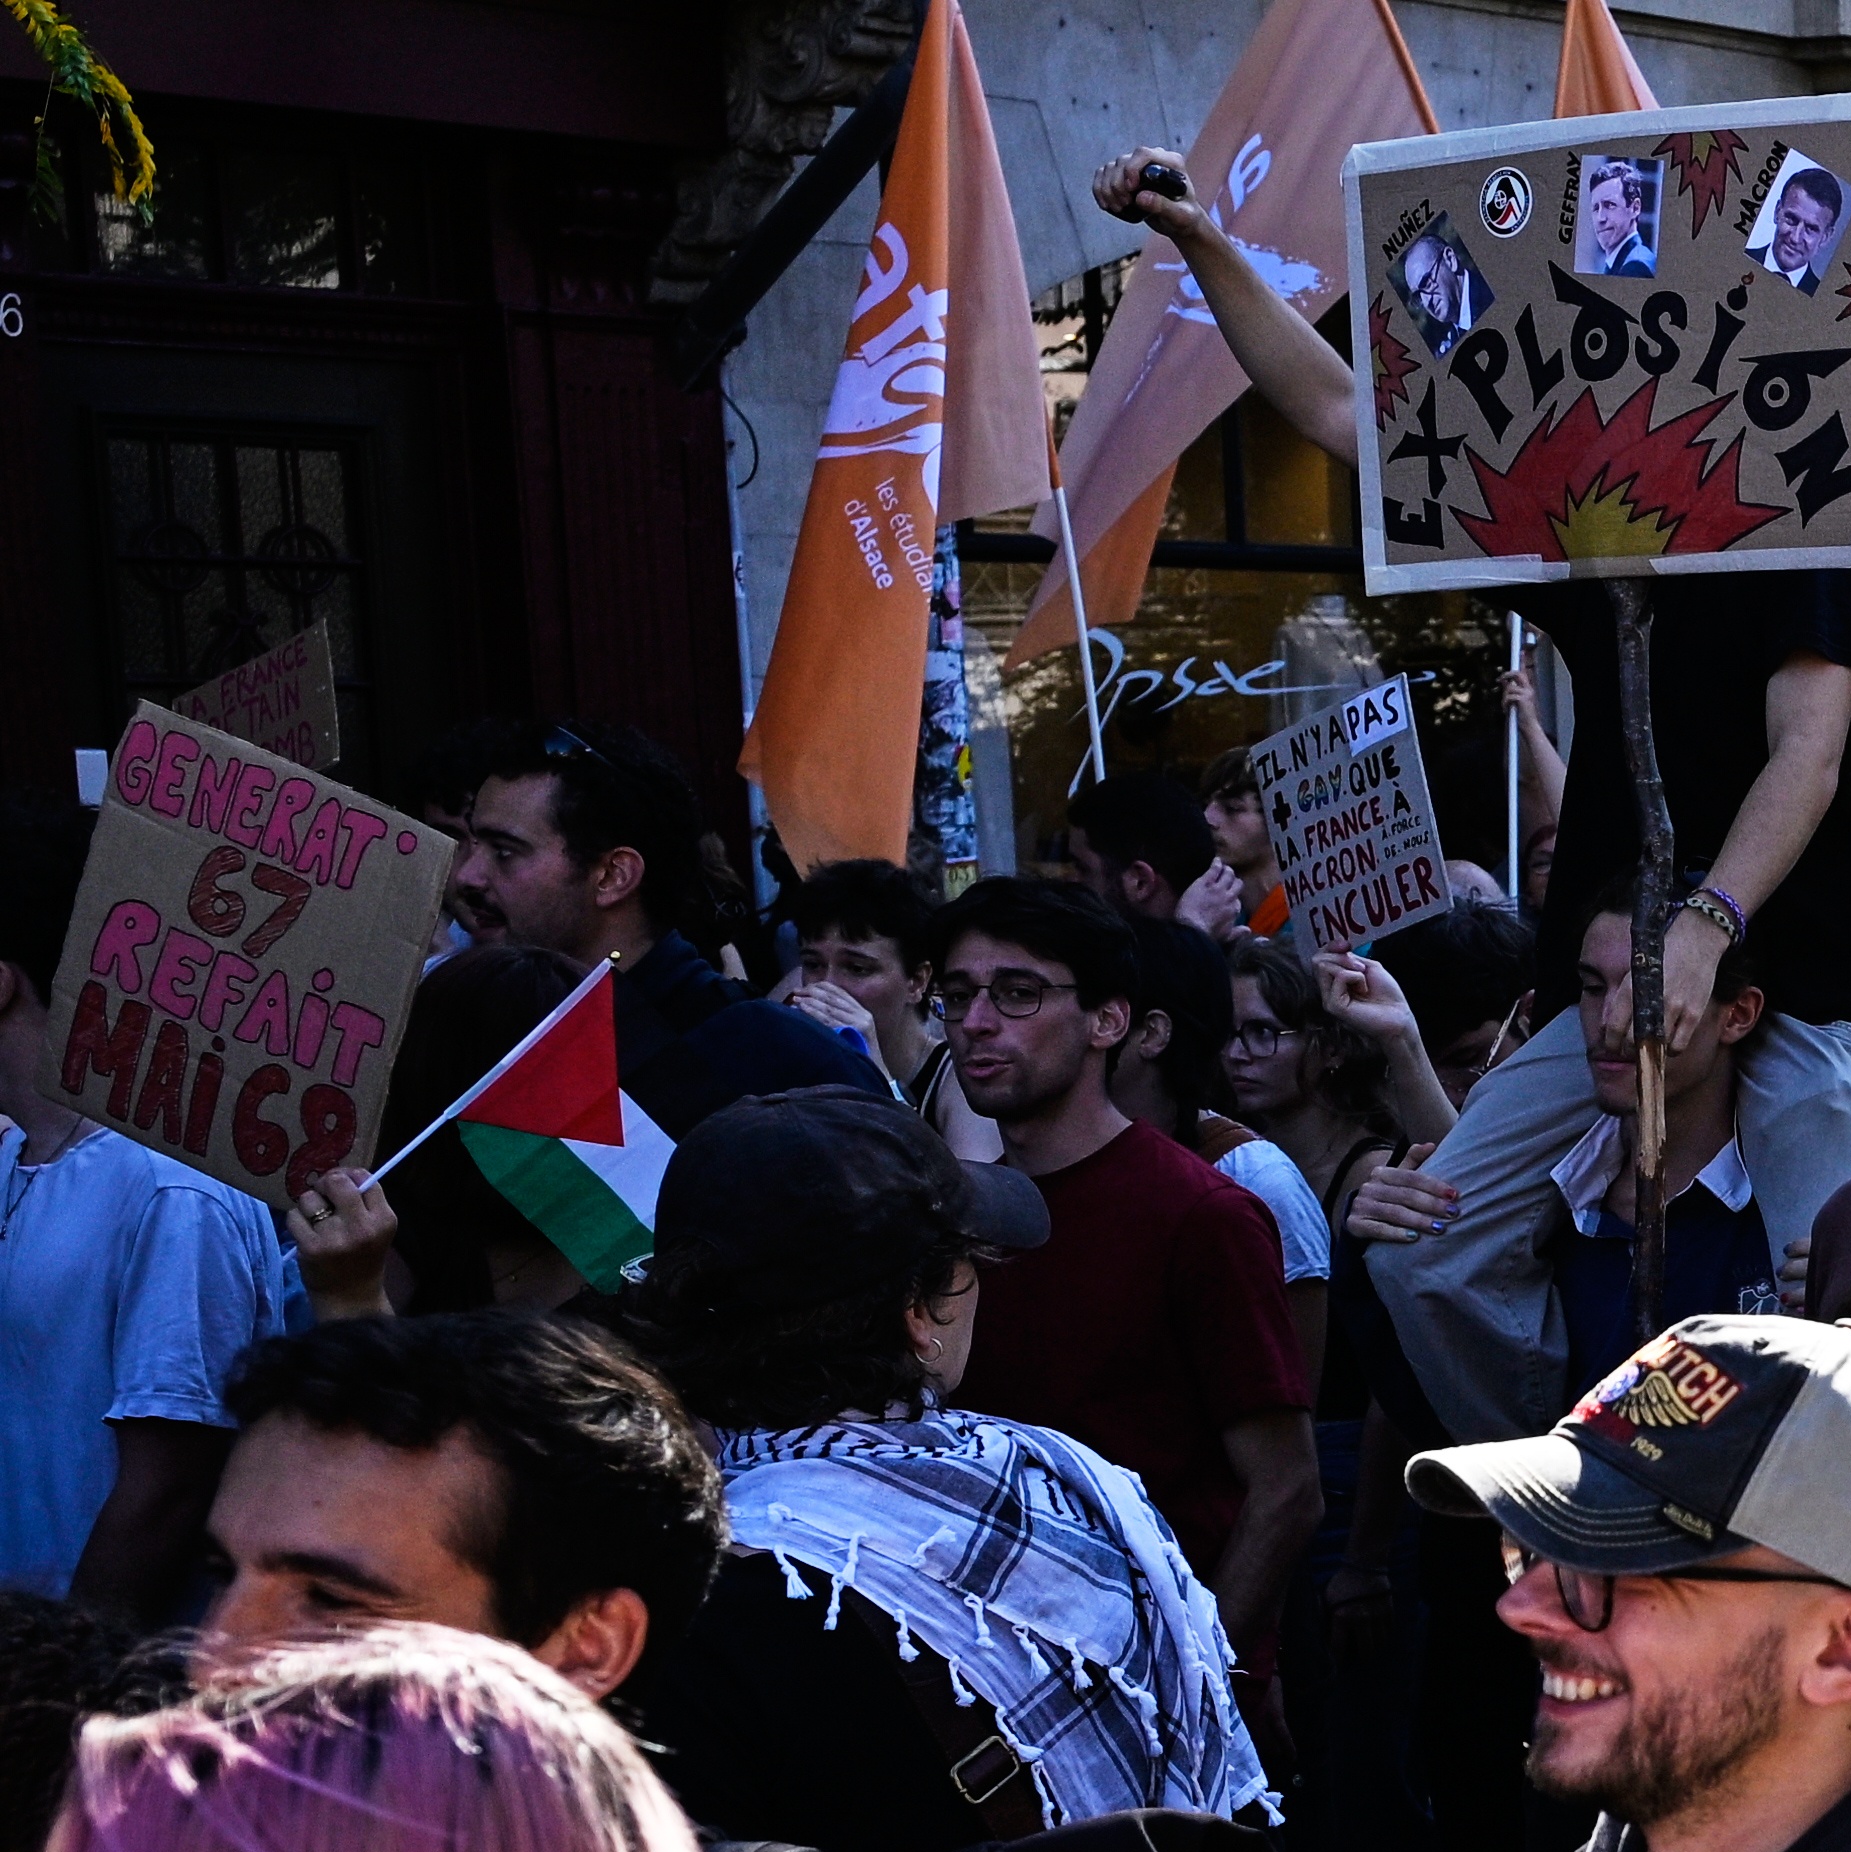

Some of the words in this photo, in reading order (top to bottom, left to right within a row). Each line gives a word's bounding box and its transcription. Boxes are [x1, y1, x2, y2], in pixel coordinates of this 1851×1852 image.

[1382, 199, 1435, 262] NUÑEZ
[1558, 152, 1582, 244] GEFFRAY
[1733, 141, 1789, 238] MACRON
[874, 476, 900, 513] les
[844, 497, 894, 592] d'Alsace
[220, 636, 308, 710] FRANCE
[1346, 686, 1399, 741] PAS
[1349, 744, 1402, 796] QUE
[1393, 780, 1411, 819] À
[188, 845, 313, 958] 67
[1308, 855, 1441, 950] ENCULER
[90, 898, 386, 1088] REFAIT
[60, 980, 225, 1158] MAI
